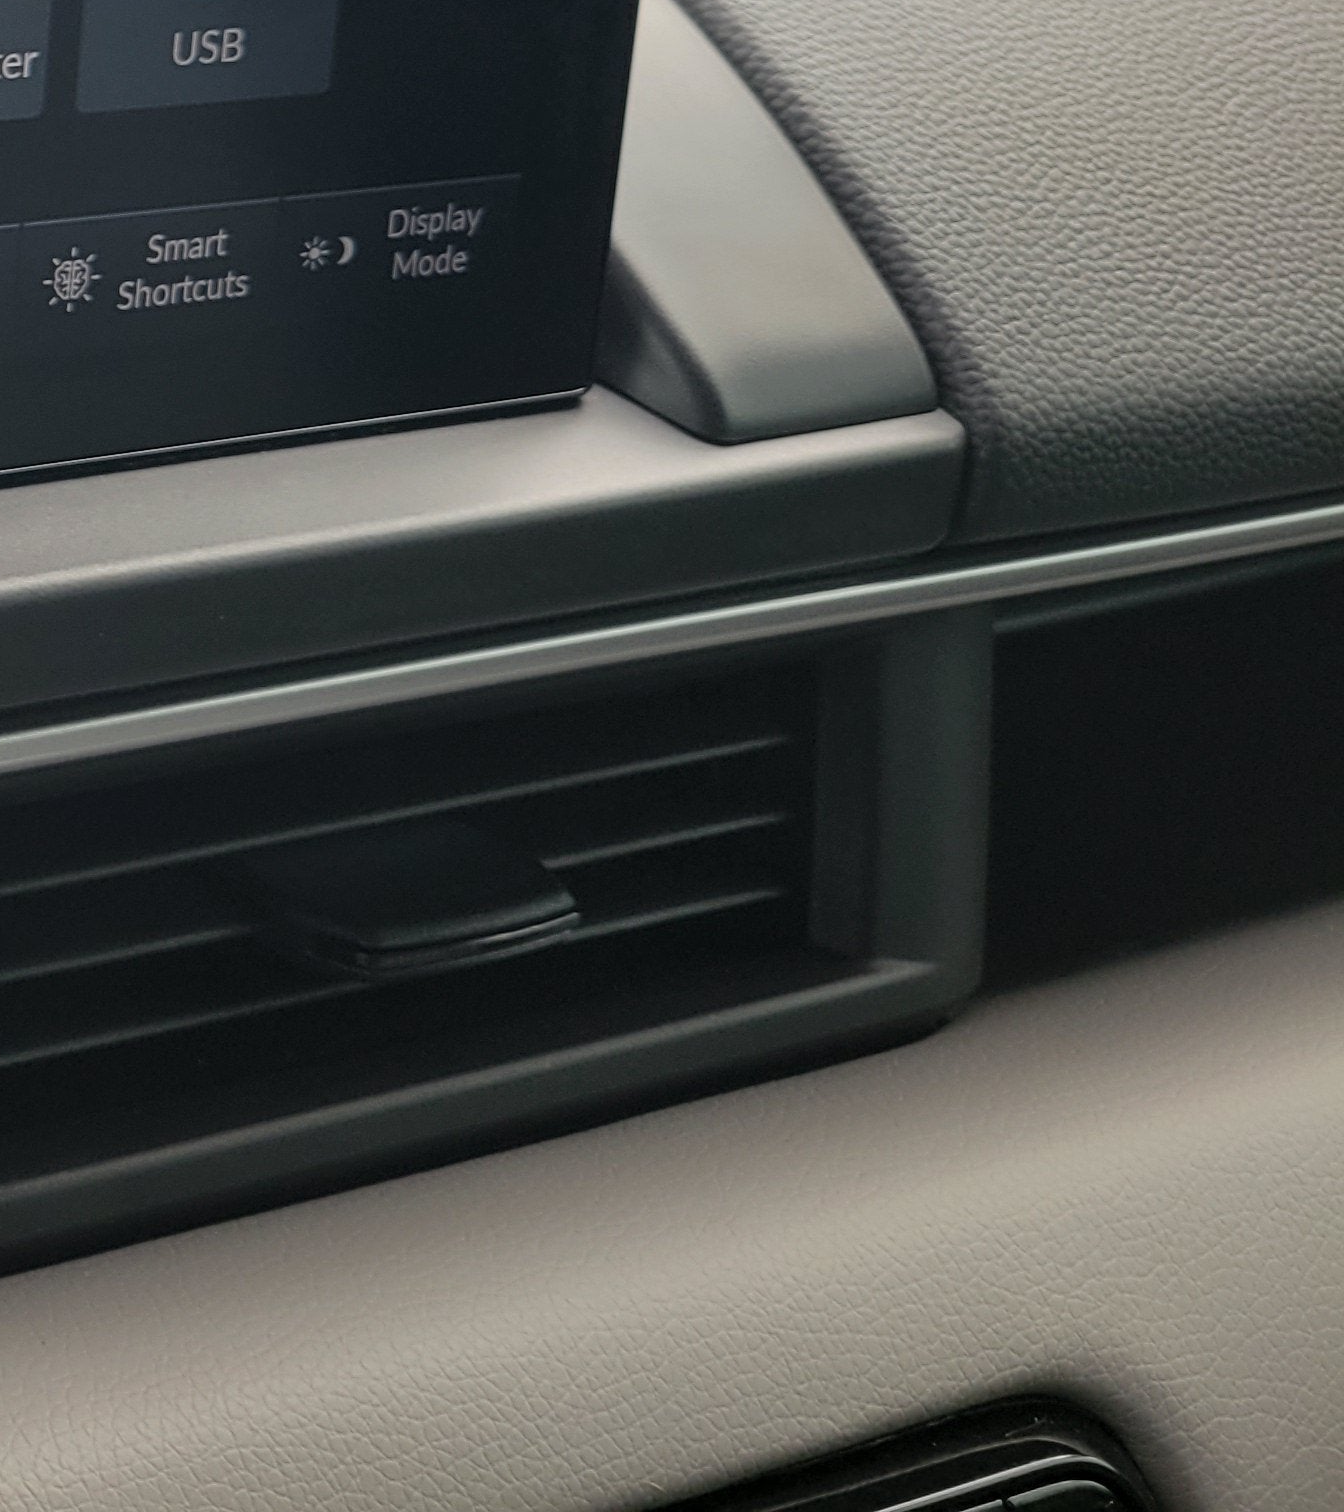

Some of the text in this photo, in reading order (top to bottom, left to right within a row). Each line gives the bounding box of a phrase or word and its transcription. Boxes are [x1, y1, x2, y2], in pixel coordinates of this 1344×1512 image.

[171, 29, 246, 67] USB
[387, 204, 483, 242] Display
[147, 230, 228, 265] Smart
[393, 246, 467, 281] Mode
[116, 270, 250, 312] Shortcuts
